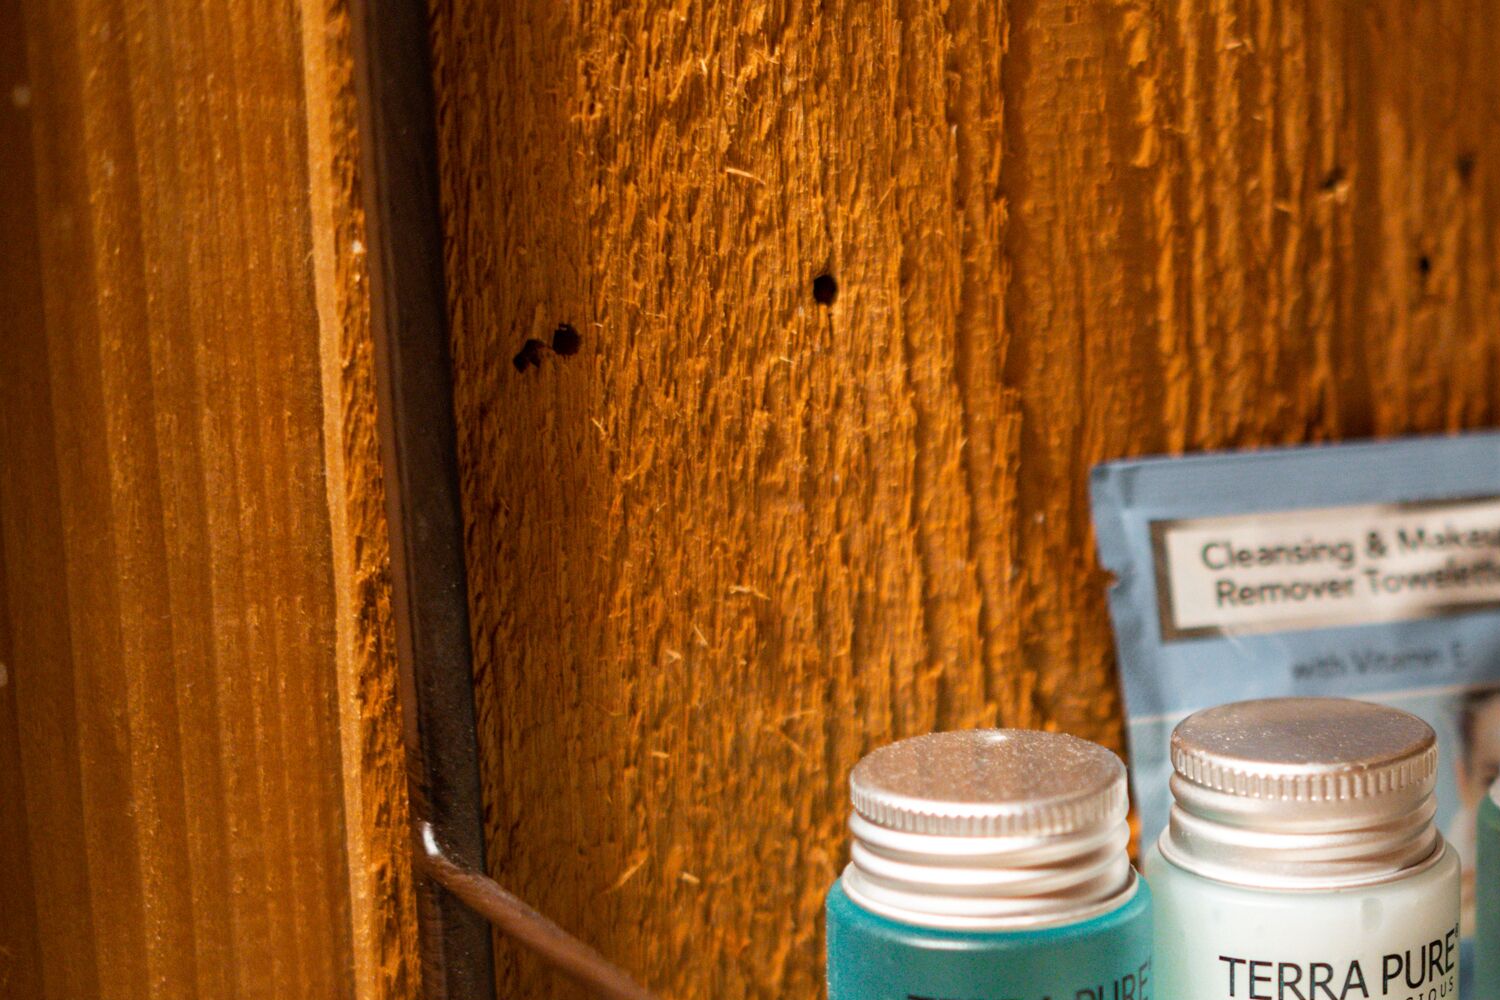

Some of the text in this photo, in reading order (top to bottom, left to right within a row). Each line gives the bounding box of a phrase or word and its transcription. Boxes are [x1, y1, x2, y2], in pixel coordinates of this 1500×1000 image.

[1200, 537, 1355, 571] Cleansing
[1365, 531, 1387, 557] &
[1214, 577, 1356, 608] Remover
